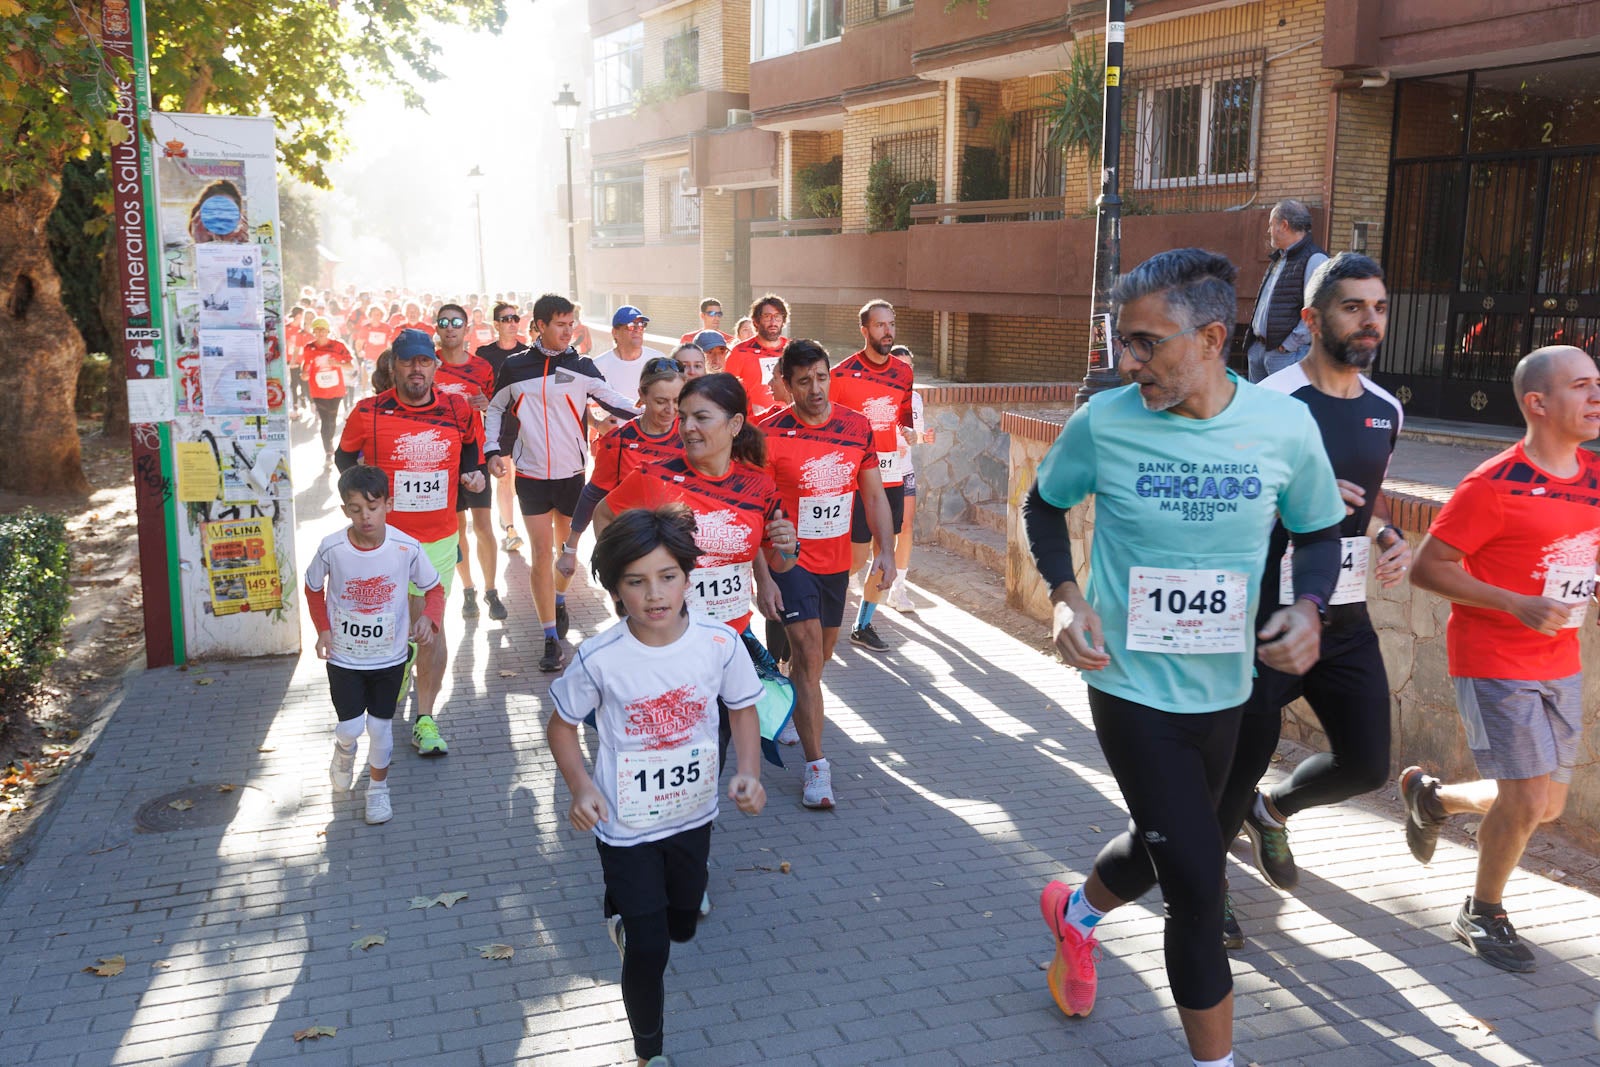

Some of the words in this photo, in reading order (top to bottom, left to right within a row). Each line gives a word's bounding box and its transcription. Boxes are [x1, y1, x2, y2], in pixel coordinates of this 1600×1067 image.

[1541, 122, 1553, 143] 2
[127, 330, 160, 338] MPS
[397, 441, 448, 453] carrera
[803, 464, 851, 480] carrera
[1138, 462, 1175, 473] BANK
[1179, 463, 1198, 473] OF
[1201, 463, 1259, 474] AMERICA
[403, 479, 440, 493] 1134
[1135, 474, 1262, 500] CHICAGO
[812, 504, 841, 519] 912
[1159, 501, 1238, 513] MARATHON
[1182, 511, 1215, 522] 2023
[247, 578, 267, 590] 149
[270, 577, 279, 588] €
[347, 586, 392, 596] carrera
[695, 574, 742, 598] 1133
[1148, 588, 1227, 614] 1048
[341, 620, 383, 638] 1050
[629, 701, 704, 726] carrera
[634, 760, 701, 793] 1135
